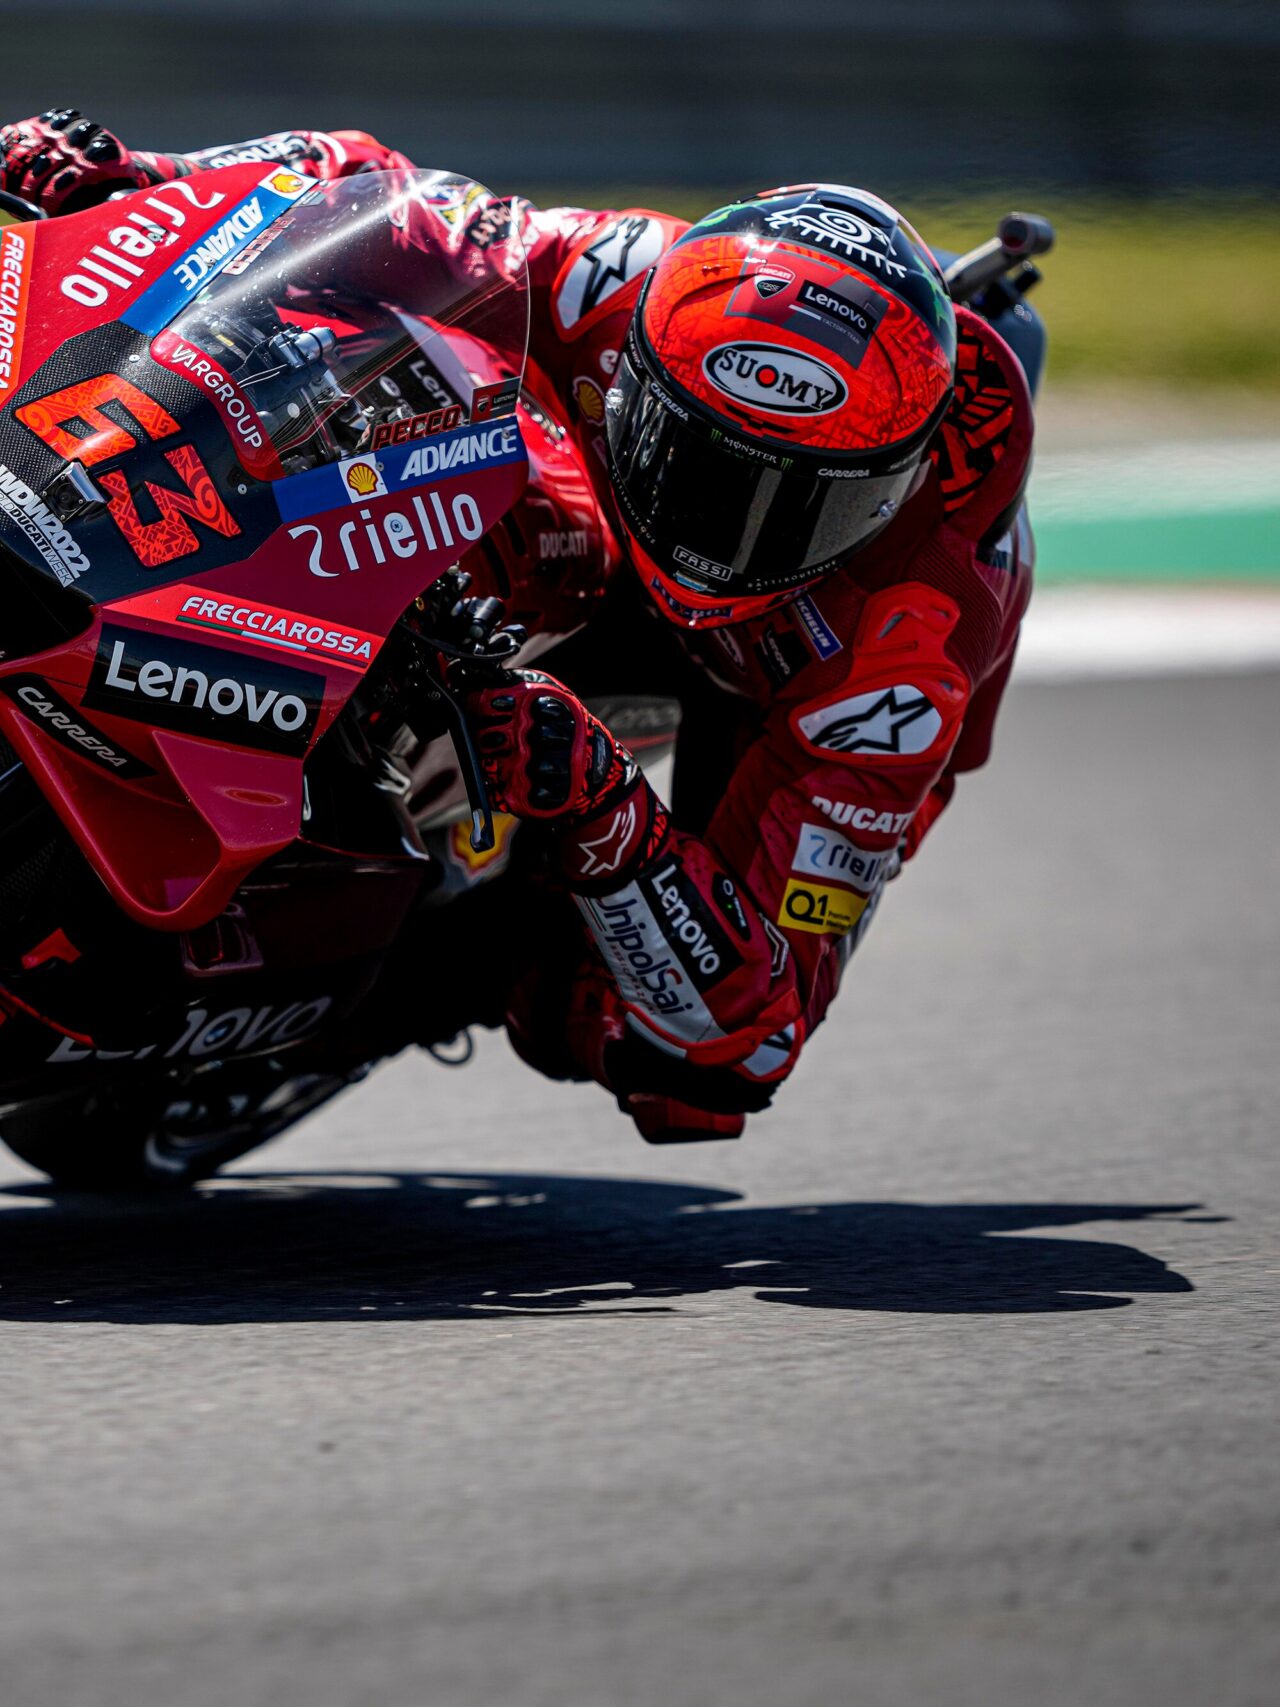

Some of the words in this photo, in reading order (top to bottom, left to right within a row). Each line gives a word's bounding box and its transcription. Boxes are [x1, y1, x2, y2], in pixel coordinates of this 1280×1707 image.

[173, 196, 264, 291] ADVANCE
[805, 286, 867, 329] Lenovo
[170, 344, 263, 449] VARGROUP
[650, 382, 689, 421] CARRERA
[718, 348, 834, 411] SUOMY
[372, 404, 461, 450] PECCO
[400, 424, 517, 481] ADVANCE
[723, 436, 778, 464] MONSTER
[15, 373, 242, 568] 63
[817, 468, 870, 478] CARRERA
[539, 531, 588, 559] DUCATI
[678, 551, 727, 577] FASSI
[181, 596, 371, 659] FRECCIAROSSA
[105, 640, 308, 731] Lenovo
[17, 686, 128, 768] CARRERA
[651, 864, 721, 975] Lenovo
[785, 890, 829, 926] Q1
